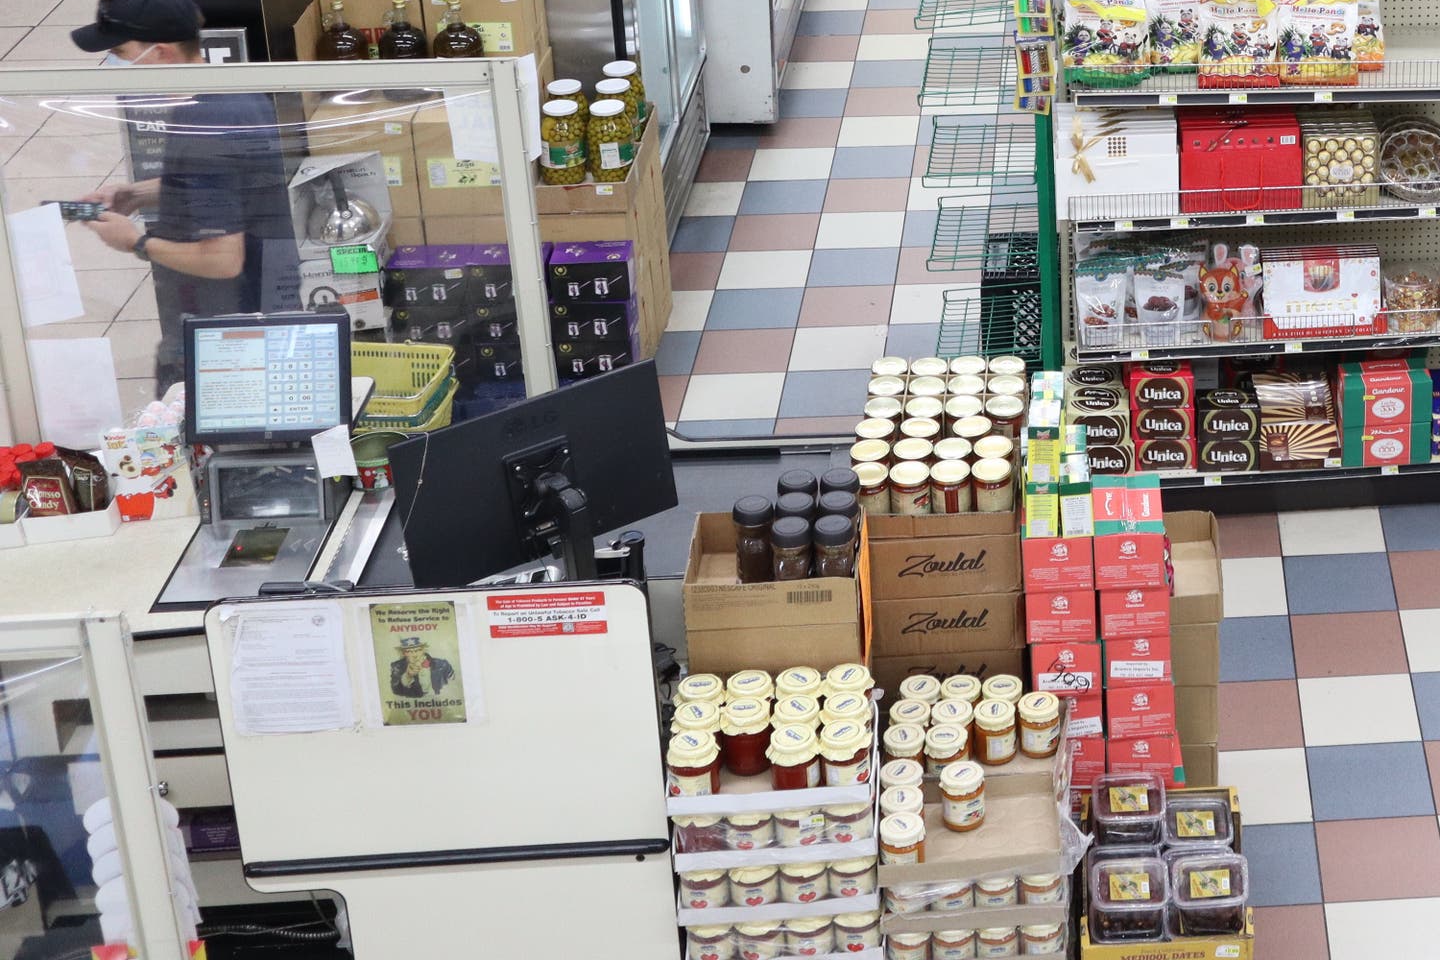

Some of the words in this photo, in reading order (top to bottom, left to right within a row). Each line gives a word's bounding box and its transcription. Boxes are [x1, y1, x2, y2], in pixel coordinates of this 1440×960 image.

[1292, 5, 1315, 15] Hello
[1286, 296, 1358, 314] merci
[1144, 388, 1182, 401] Unica
[1145, 419, 1183, 432] Unica
[1212, 420, 1250, 433] Unica
[1147, 449, 1185, 462] Unica
[1211, 449, 1248, 463] Unica
[1089, 456, 1124, 469] Unica
[898, 549, 987, 578] Zoulal
[431, 607, 450, 615] Right
[546, 614, 587, 622] ASK-4-ID
[901, 608, 989, 635] Zoulal
[390, 624, 438, 633] ANYBODY
[385, 700, 411, 709] This
[414, 698, 463, 708] Includes
[407, 709, 443, 721] YOU
[1172, 951, 1206, 960] DATES
